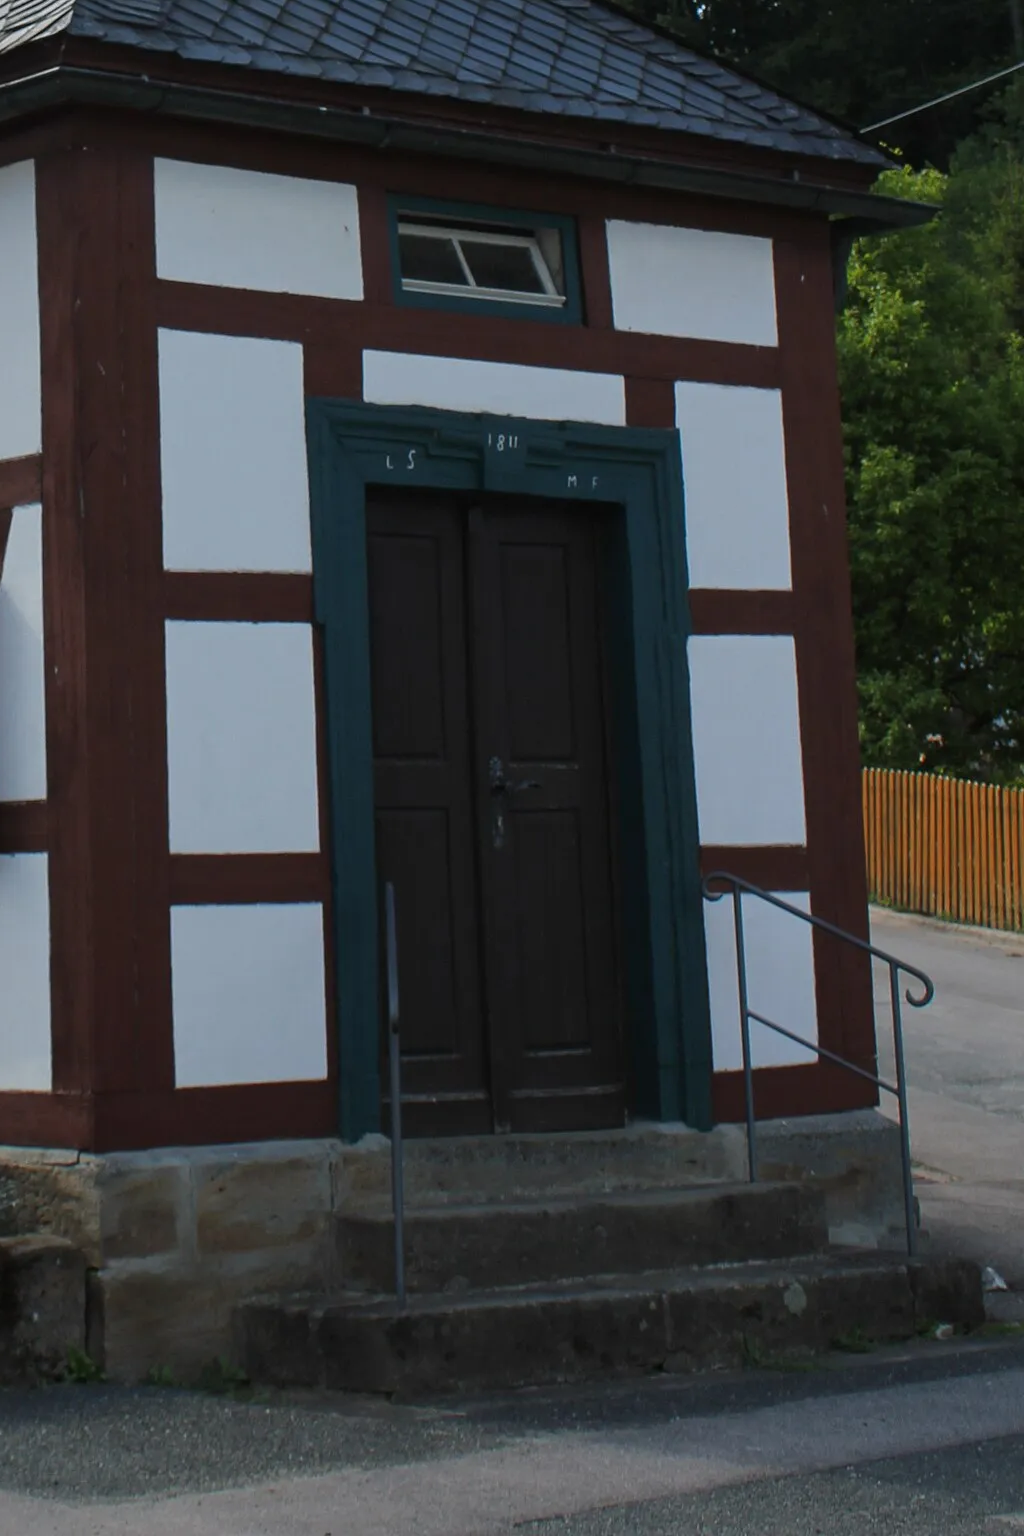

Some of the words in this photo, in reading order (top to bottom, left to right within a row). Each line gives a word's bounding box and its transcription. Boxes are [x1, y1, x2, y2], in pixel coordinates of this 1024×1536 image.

[488, 433, 518, 451] 1811
[407, 449, 416, 470] S
[567, 475, 577, 488] M
[592, 476, 599, 489] F
